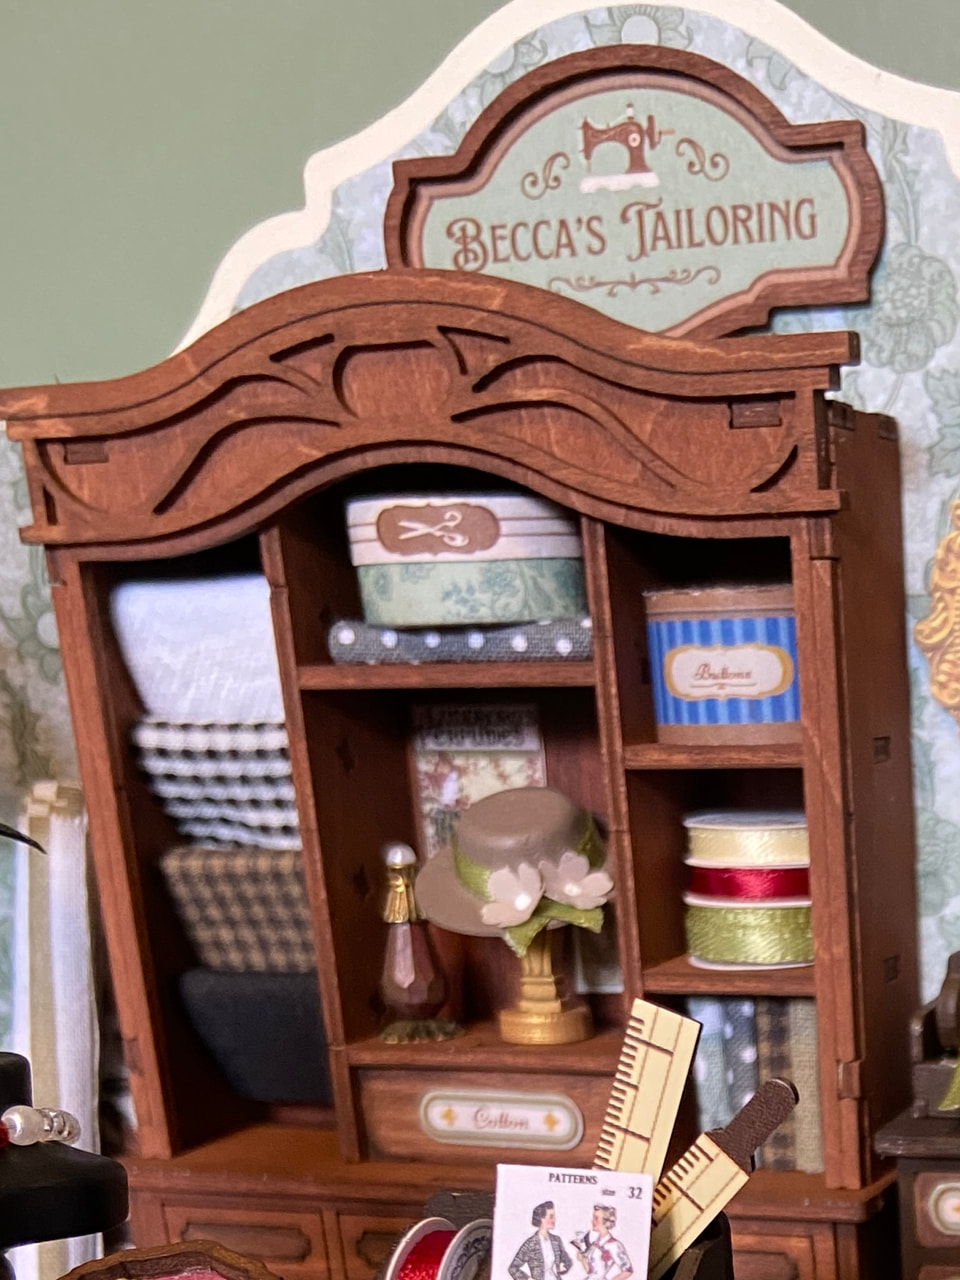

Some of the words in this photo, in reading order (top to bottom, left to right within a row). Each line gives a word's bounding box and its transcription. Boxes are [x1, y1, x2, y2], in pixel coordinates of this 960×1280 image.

[446, 215, 607, 273] BECCA'S
[620, 197, 817, 262] TAILORING
[473, 1104, 539, 1130] Cotton
[548, 1173, 598, 1185] PATTERNS
[628, 1187, 643, 1200] 32
